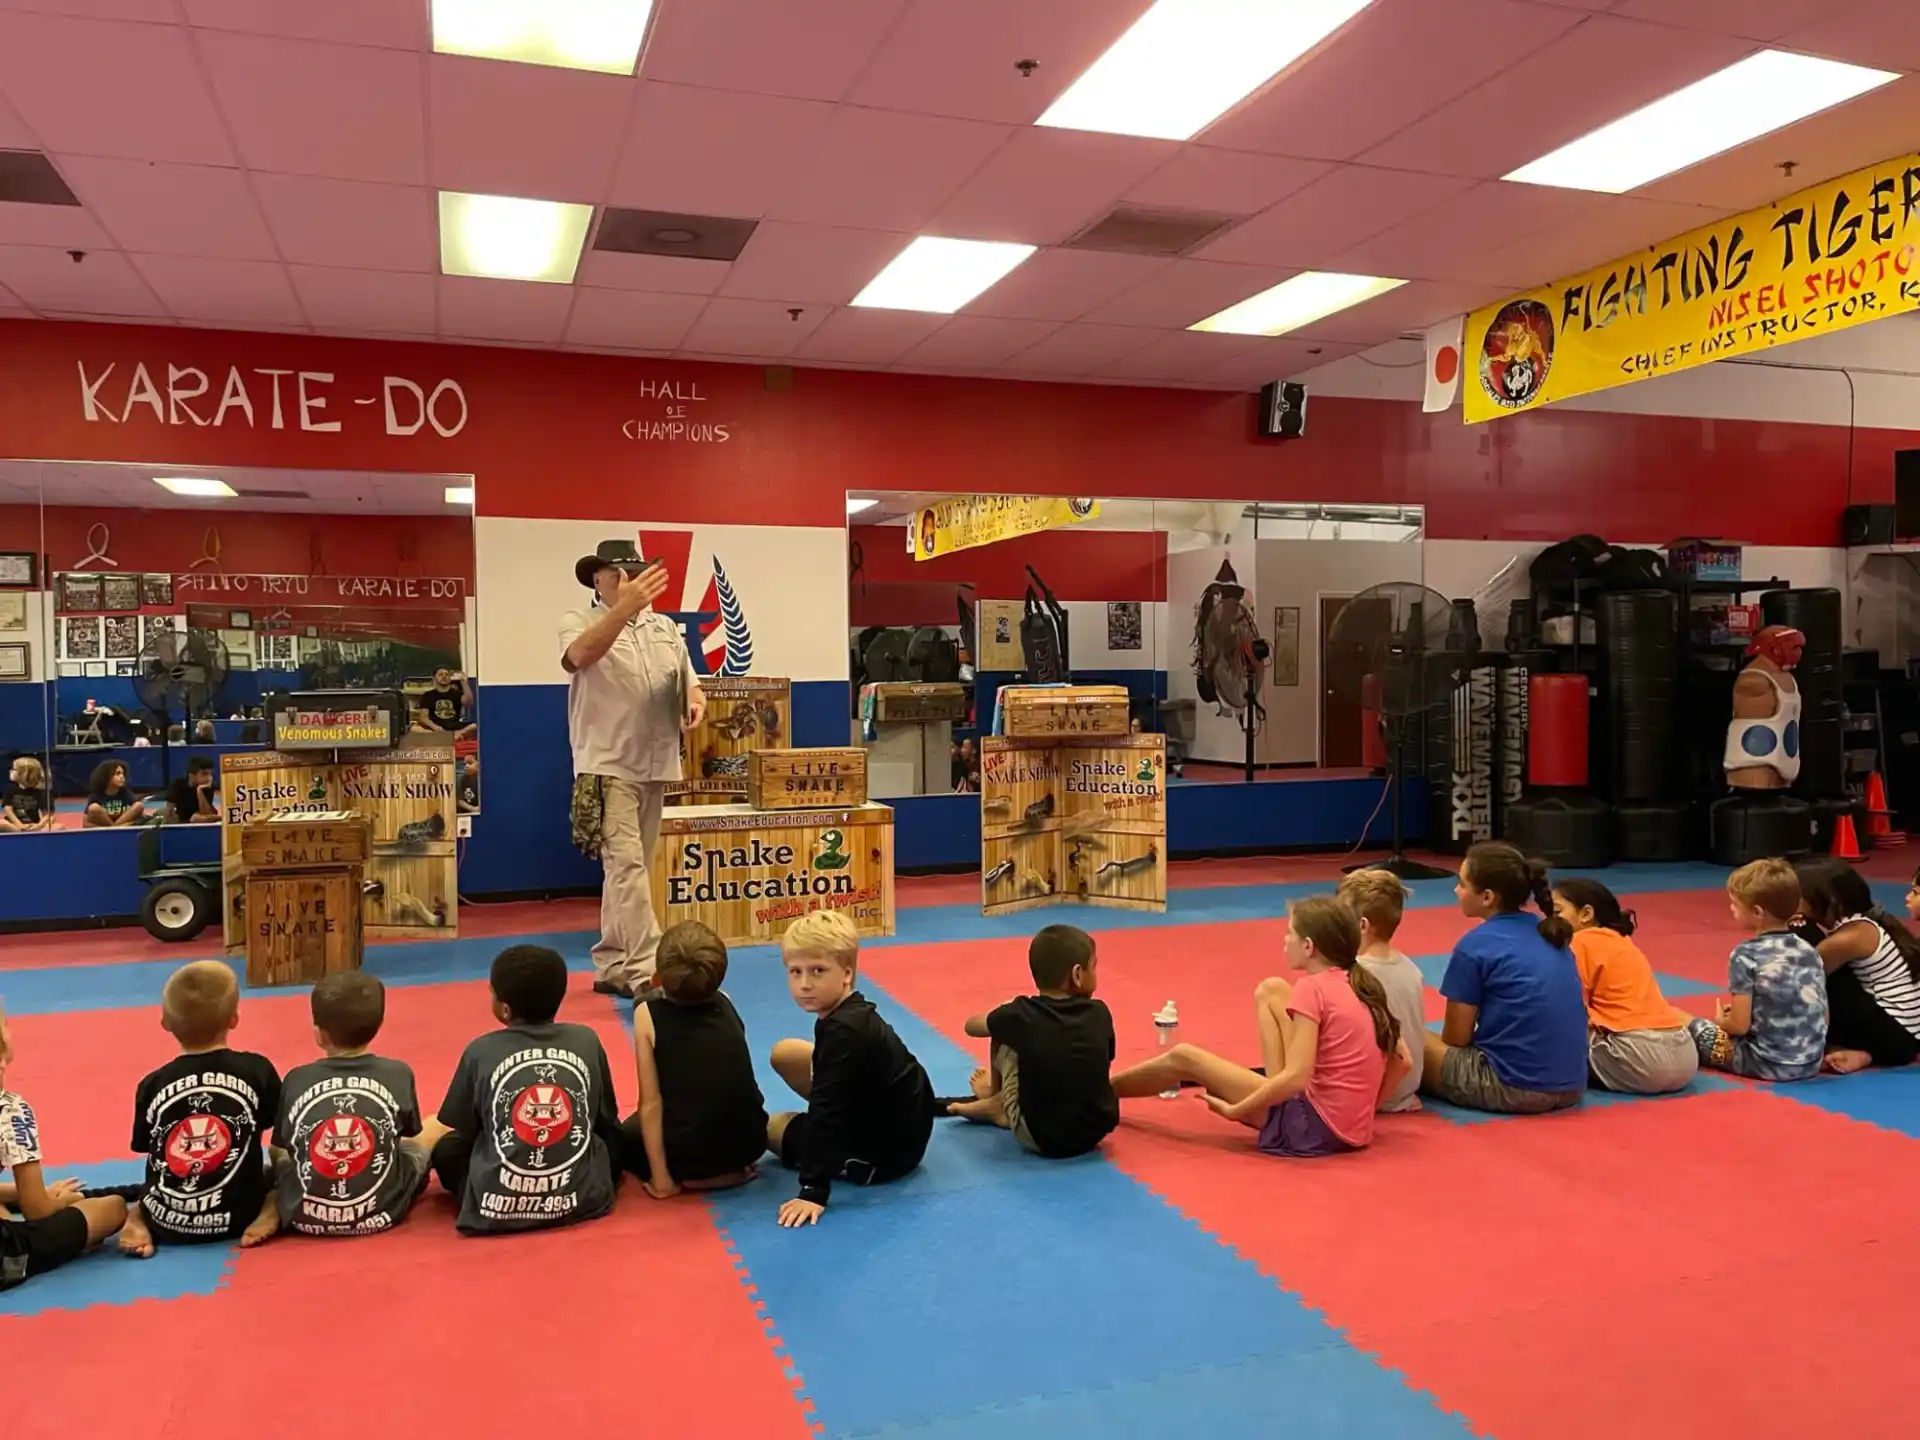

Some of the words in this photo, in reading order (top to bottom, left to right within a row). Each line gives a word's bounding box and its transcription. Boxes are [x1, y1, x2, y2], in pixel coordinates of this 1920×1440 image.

[1560, 226, 1754, 336] FIGHTING
[1708, 281, 1787, 330] NISEI
[1620, 341, 1693, 374] CHIEF
[1700, 291, 1886, 356] INSTRUCTOR,
[640, 380, 707, 401] HALL
[666, 405, 687, 418] OF
[622, 420, 731, 442] CHAMPIONS
[1520, 666, 1529, 731] CENTURY
[300, 712, 367, 726] DAGER!
[1050, 703, 1094, 717] LIVE
[279, 725, 342, 742] Venomous
[346, 723, 387, 740] Snakes
[1046, 719, 1100, 731] SNAKE
[339, 763, 369, 784] LIVE
[791, 762, 838, 775] LIVE
[987, 767, 1025, 785] SNAKE
[1072, 759, 1126, 776] Snake
[236, 782, 297, 802] Snake
[343, 783, 400, 799] SNAKE
[405, 783, 453, 799] SHOW
[786, 779, 844, 792] SNAKE
[1065, 778, 1157, 796] Education
[1452, 771, 1473, 841] XXL
[271, 828, 333, 844] LIVE
[265, 847, 343, 864] SNAKE
[684, 839, 794, 871] Snake
[668, 869, 854, 905] Education
[266, 900, 326, 917] LIVE
[260, 919, 336, 937] SNAKE
[500, 1168, 572, 1193] KARATE
[303, 1195, 377, 1223] KARATE
[481, 1192, 516, 1213] (407)
[517, 1191, 578, 1213] 877-9951
[165, 1211, 231, 1228] 877-9951
